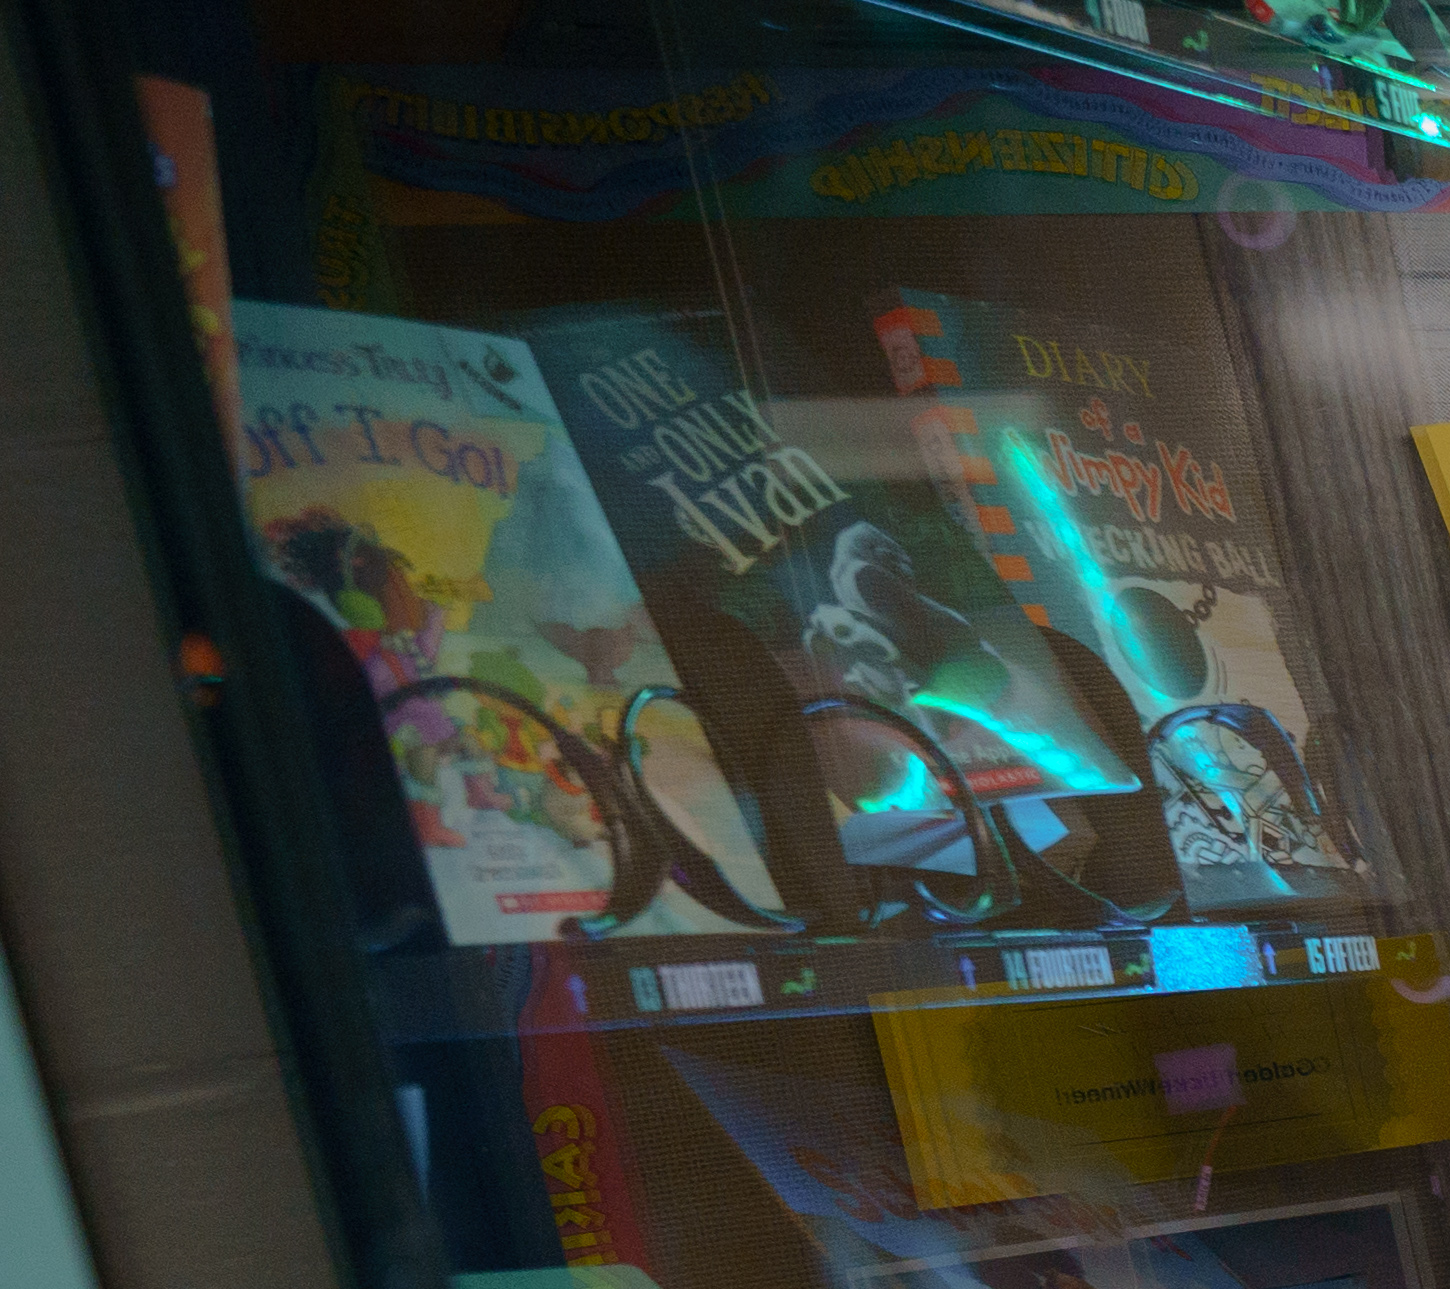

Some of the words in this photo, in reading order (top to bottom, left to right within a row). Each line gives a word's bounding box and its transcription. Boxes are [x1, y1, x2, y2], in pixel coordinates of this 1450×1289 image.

[578, 347, 699, 431] ONE
[1011, 334, 1156, 399] DIARY
[652, 388, 783, 483] ONLY
[1078, 397, 1116, 443] of
[1125, 420, 1148, 447] a
[645, 444, 853, 577] Ivan
[1153, 437, 1240, 525] Kid
[1203, 538, 1283, 591] BALL
